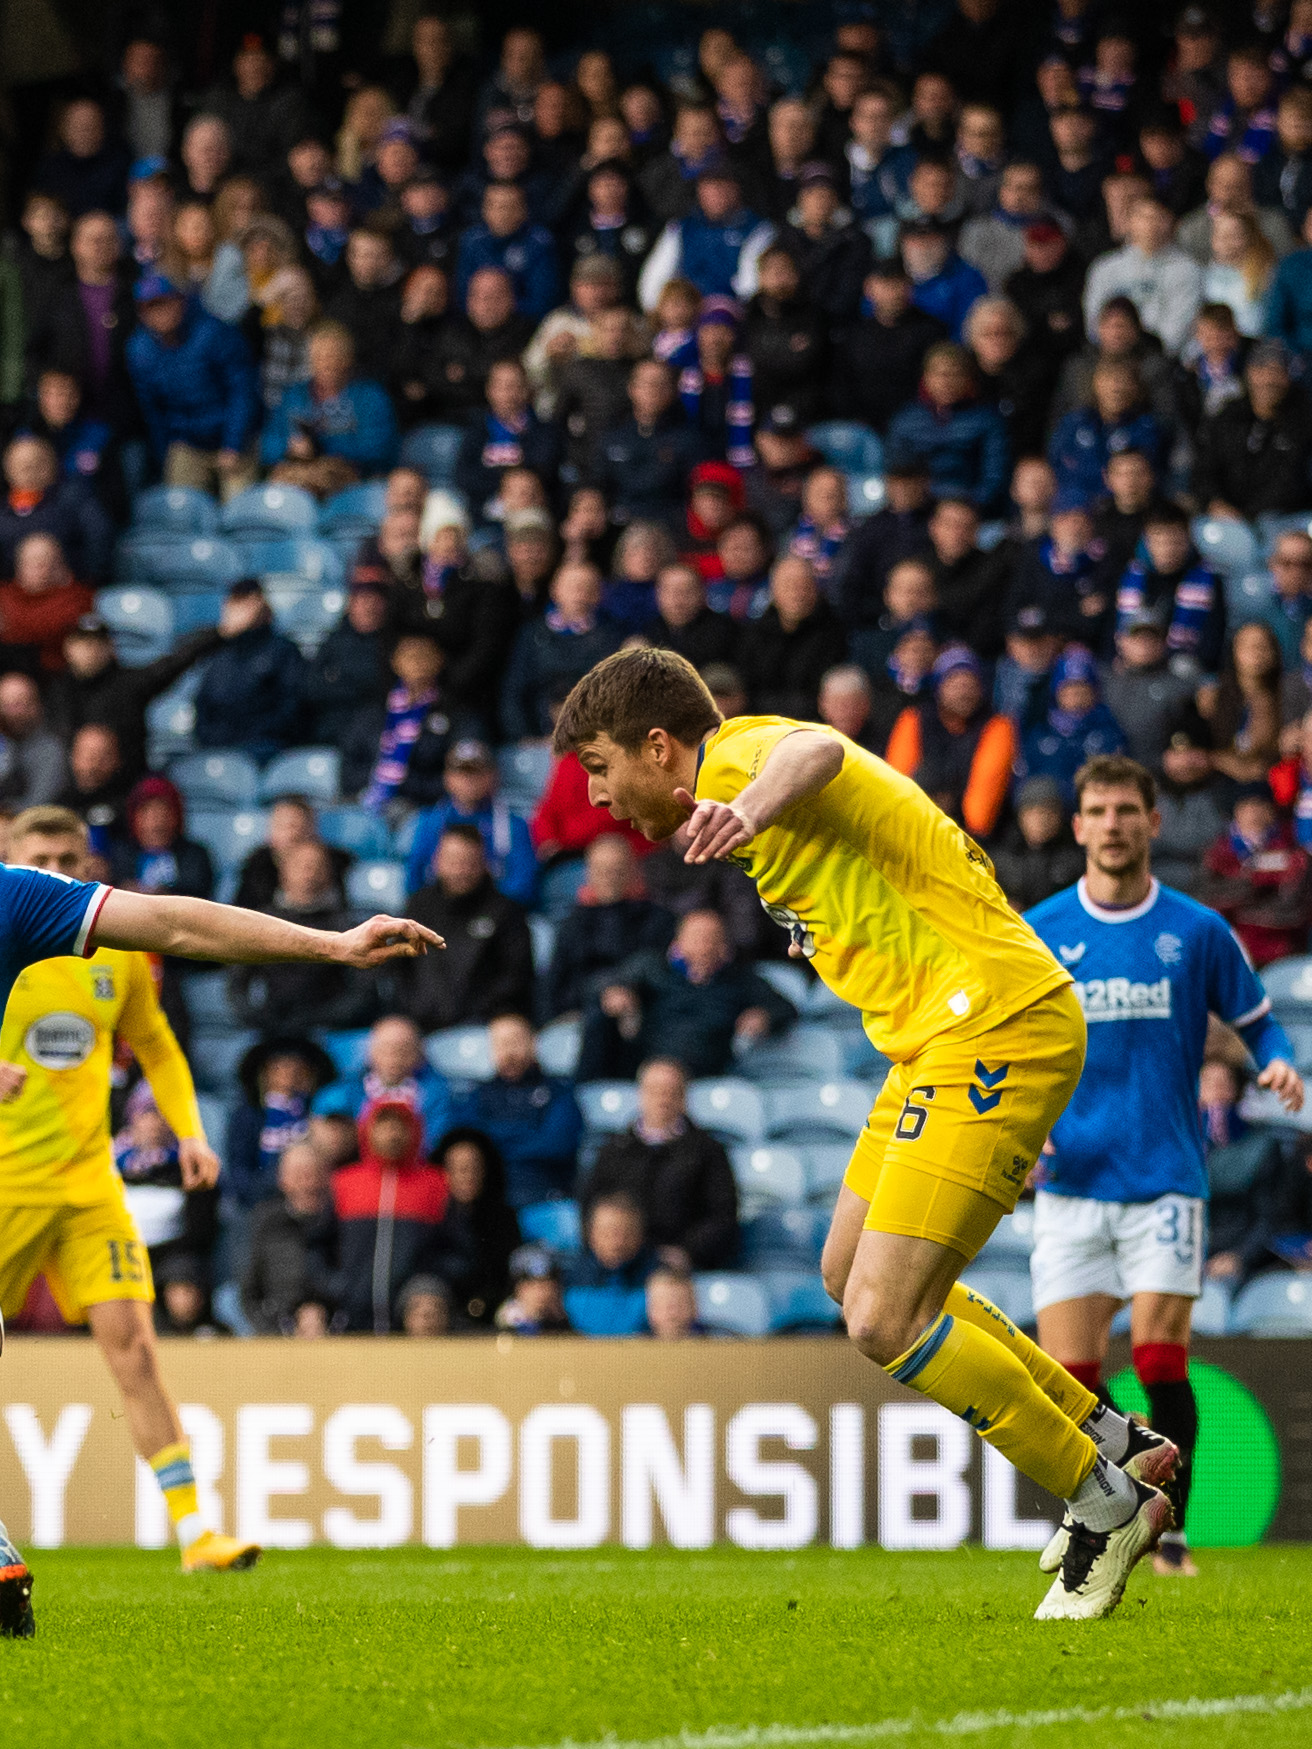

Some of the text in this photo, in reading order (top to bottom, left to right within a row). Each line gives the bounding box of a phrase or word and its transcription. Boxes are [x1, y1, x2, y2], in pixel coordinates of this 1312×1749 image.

[894, 1086, 937, 1141] 6
[107, 1239, 144, 1283] 15
[134, 1401, 1058, 1551] RESPONSIBL
